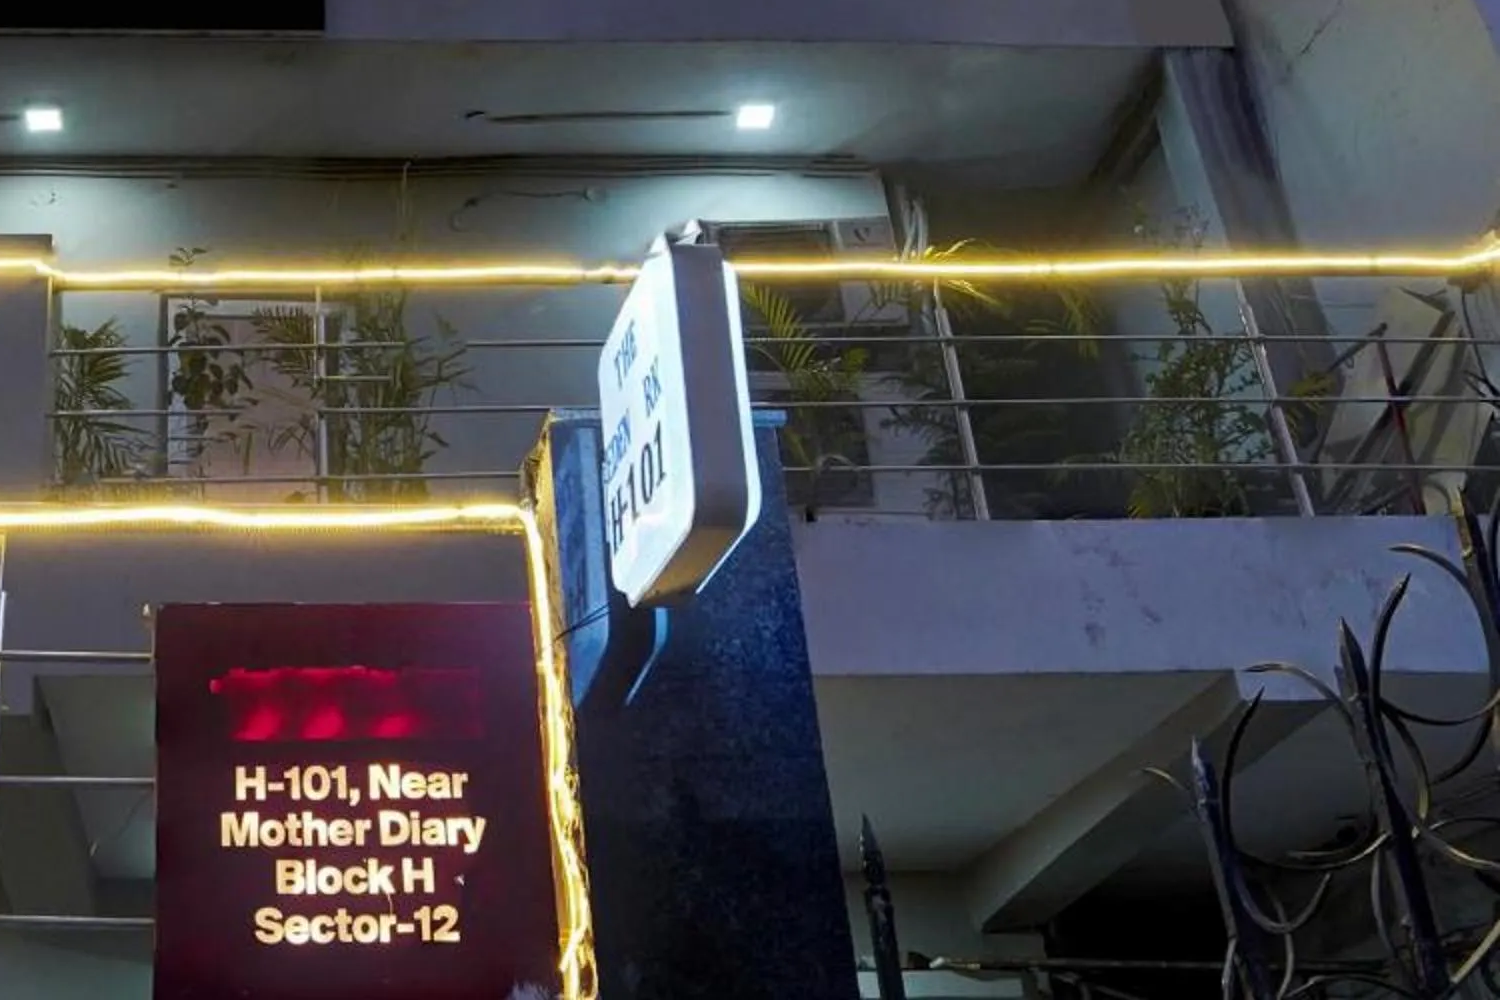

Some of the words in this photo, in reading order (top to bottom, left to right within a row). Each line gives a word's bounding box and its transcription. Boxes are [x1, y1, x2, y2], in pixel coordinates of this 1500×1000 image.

[614, 318, 636, 390] THE
[611, 419, 666, 555] H-101
[236, 766, 360, 806] H-101,
[368, 764, 468, 800] Near
[221, 811, 372, 846] Mother
[378, 810, 486, 854] Diary
[276, 858, 396, 894] Block
[402, 857, 434, 893] H
[255, 905, 460, 945] Sector-12
